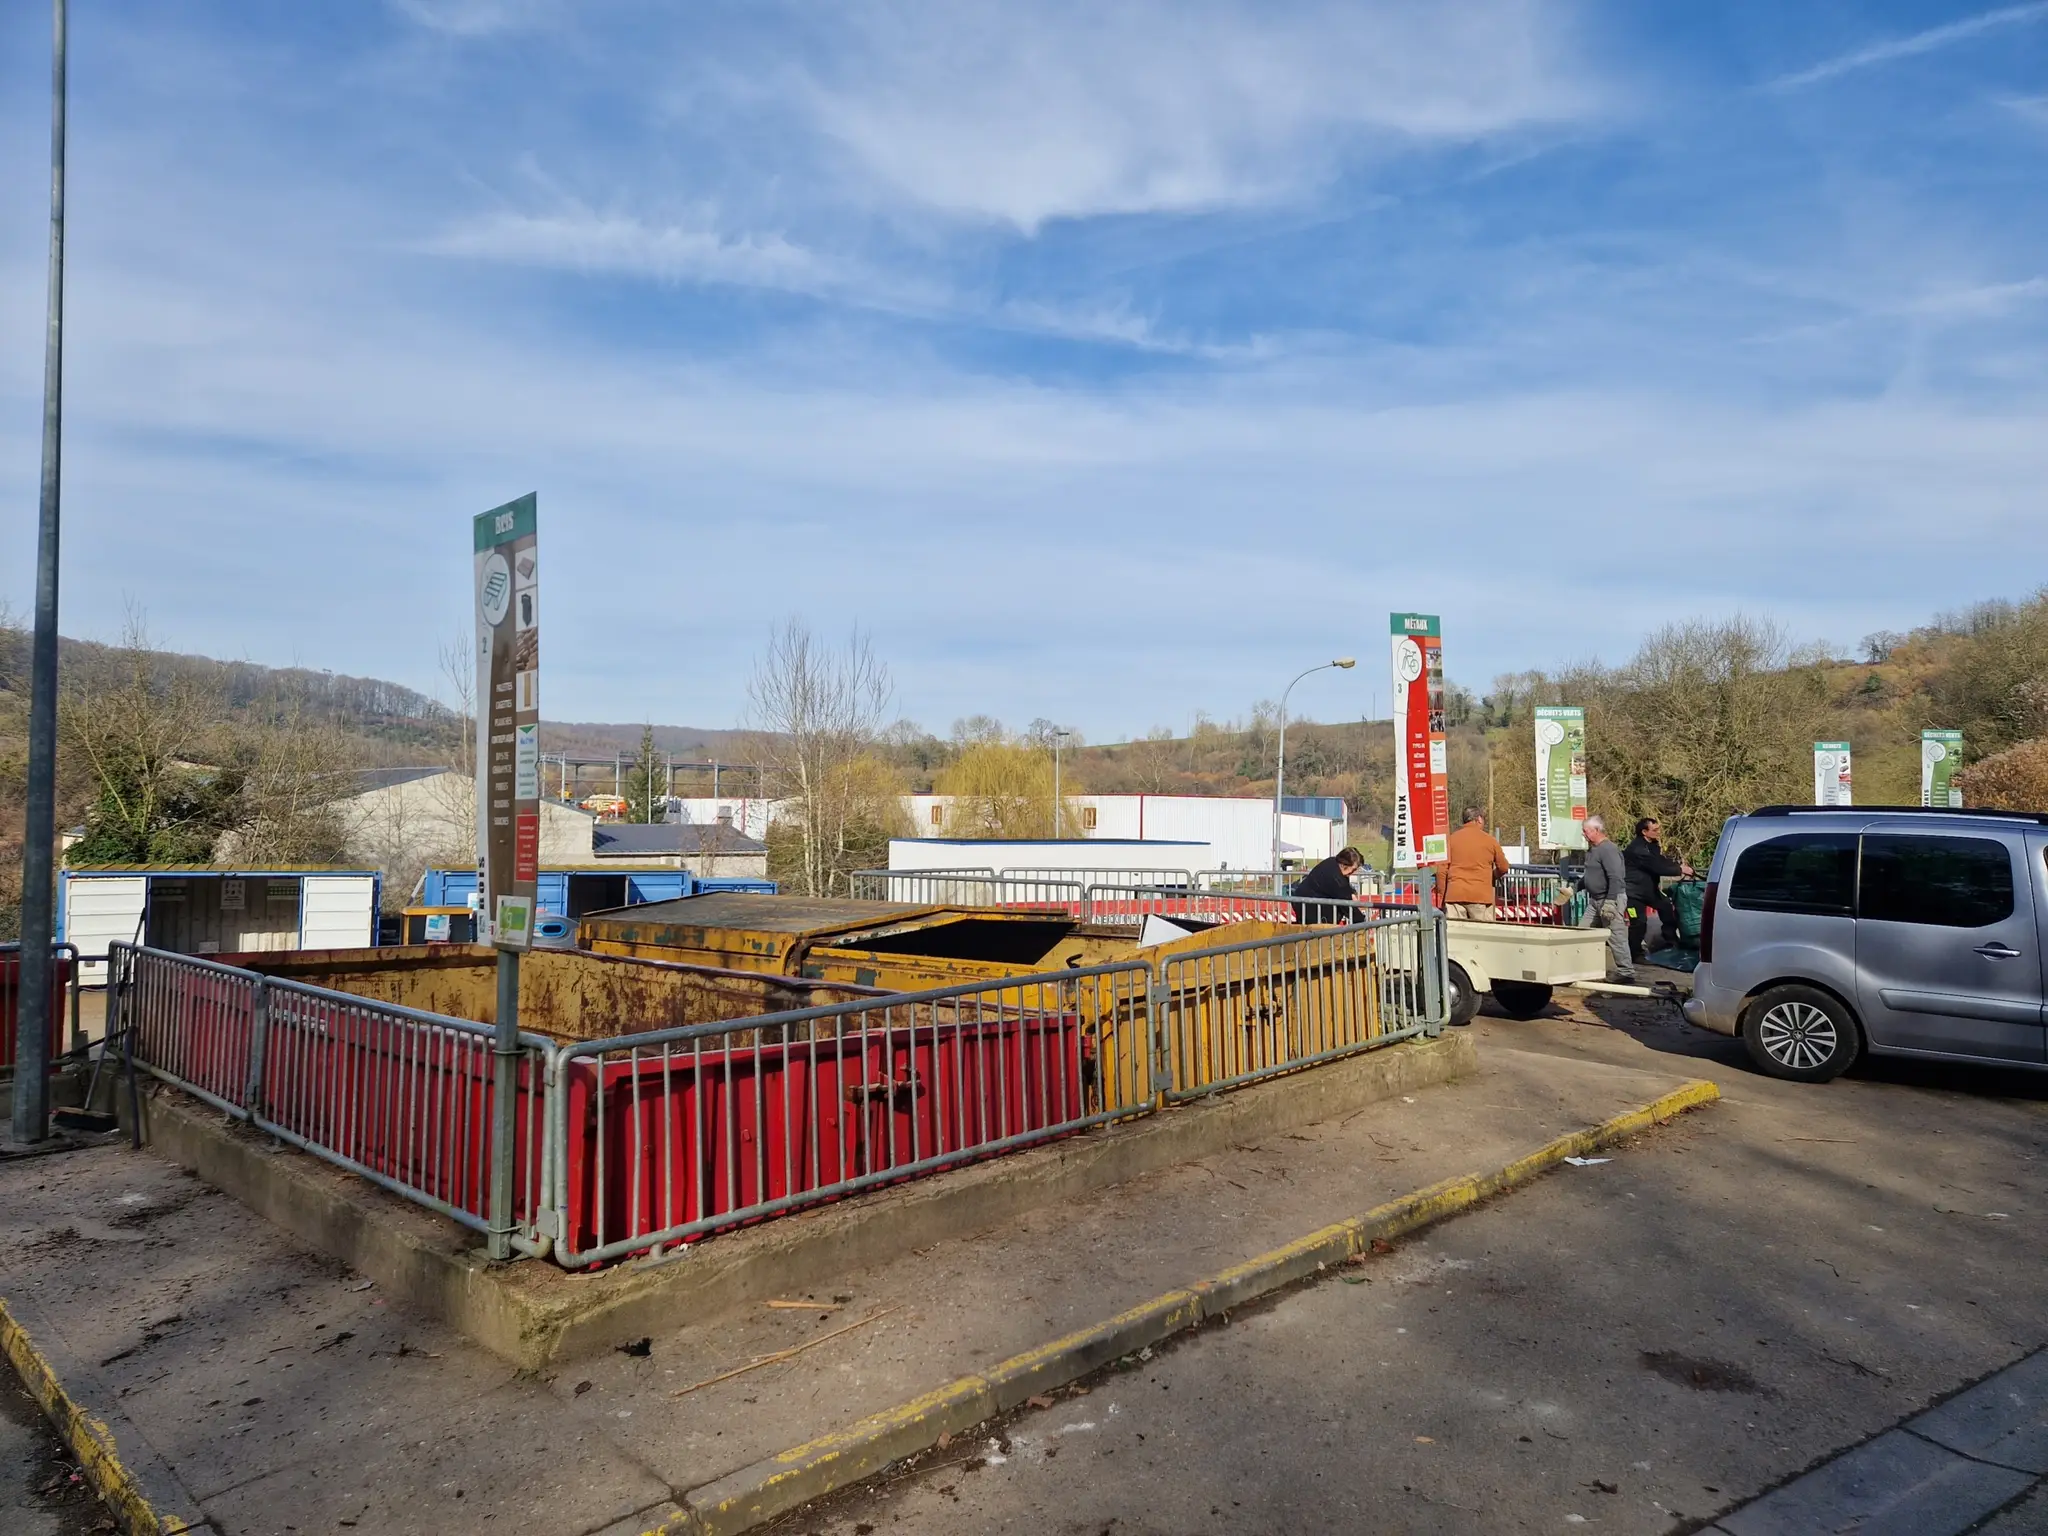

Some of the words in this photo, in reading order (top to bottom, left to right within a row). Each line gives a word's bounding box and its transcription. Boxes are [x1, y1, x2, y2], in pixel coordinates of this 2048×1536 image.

[1404, 616, 1428, 631] MÉTAUX
[1397, 683, 1402, 694] 3
[1397, 794, 1407, 847] METAUX
